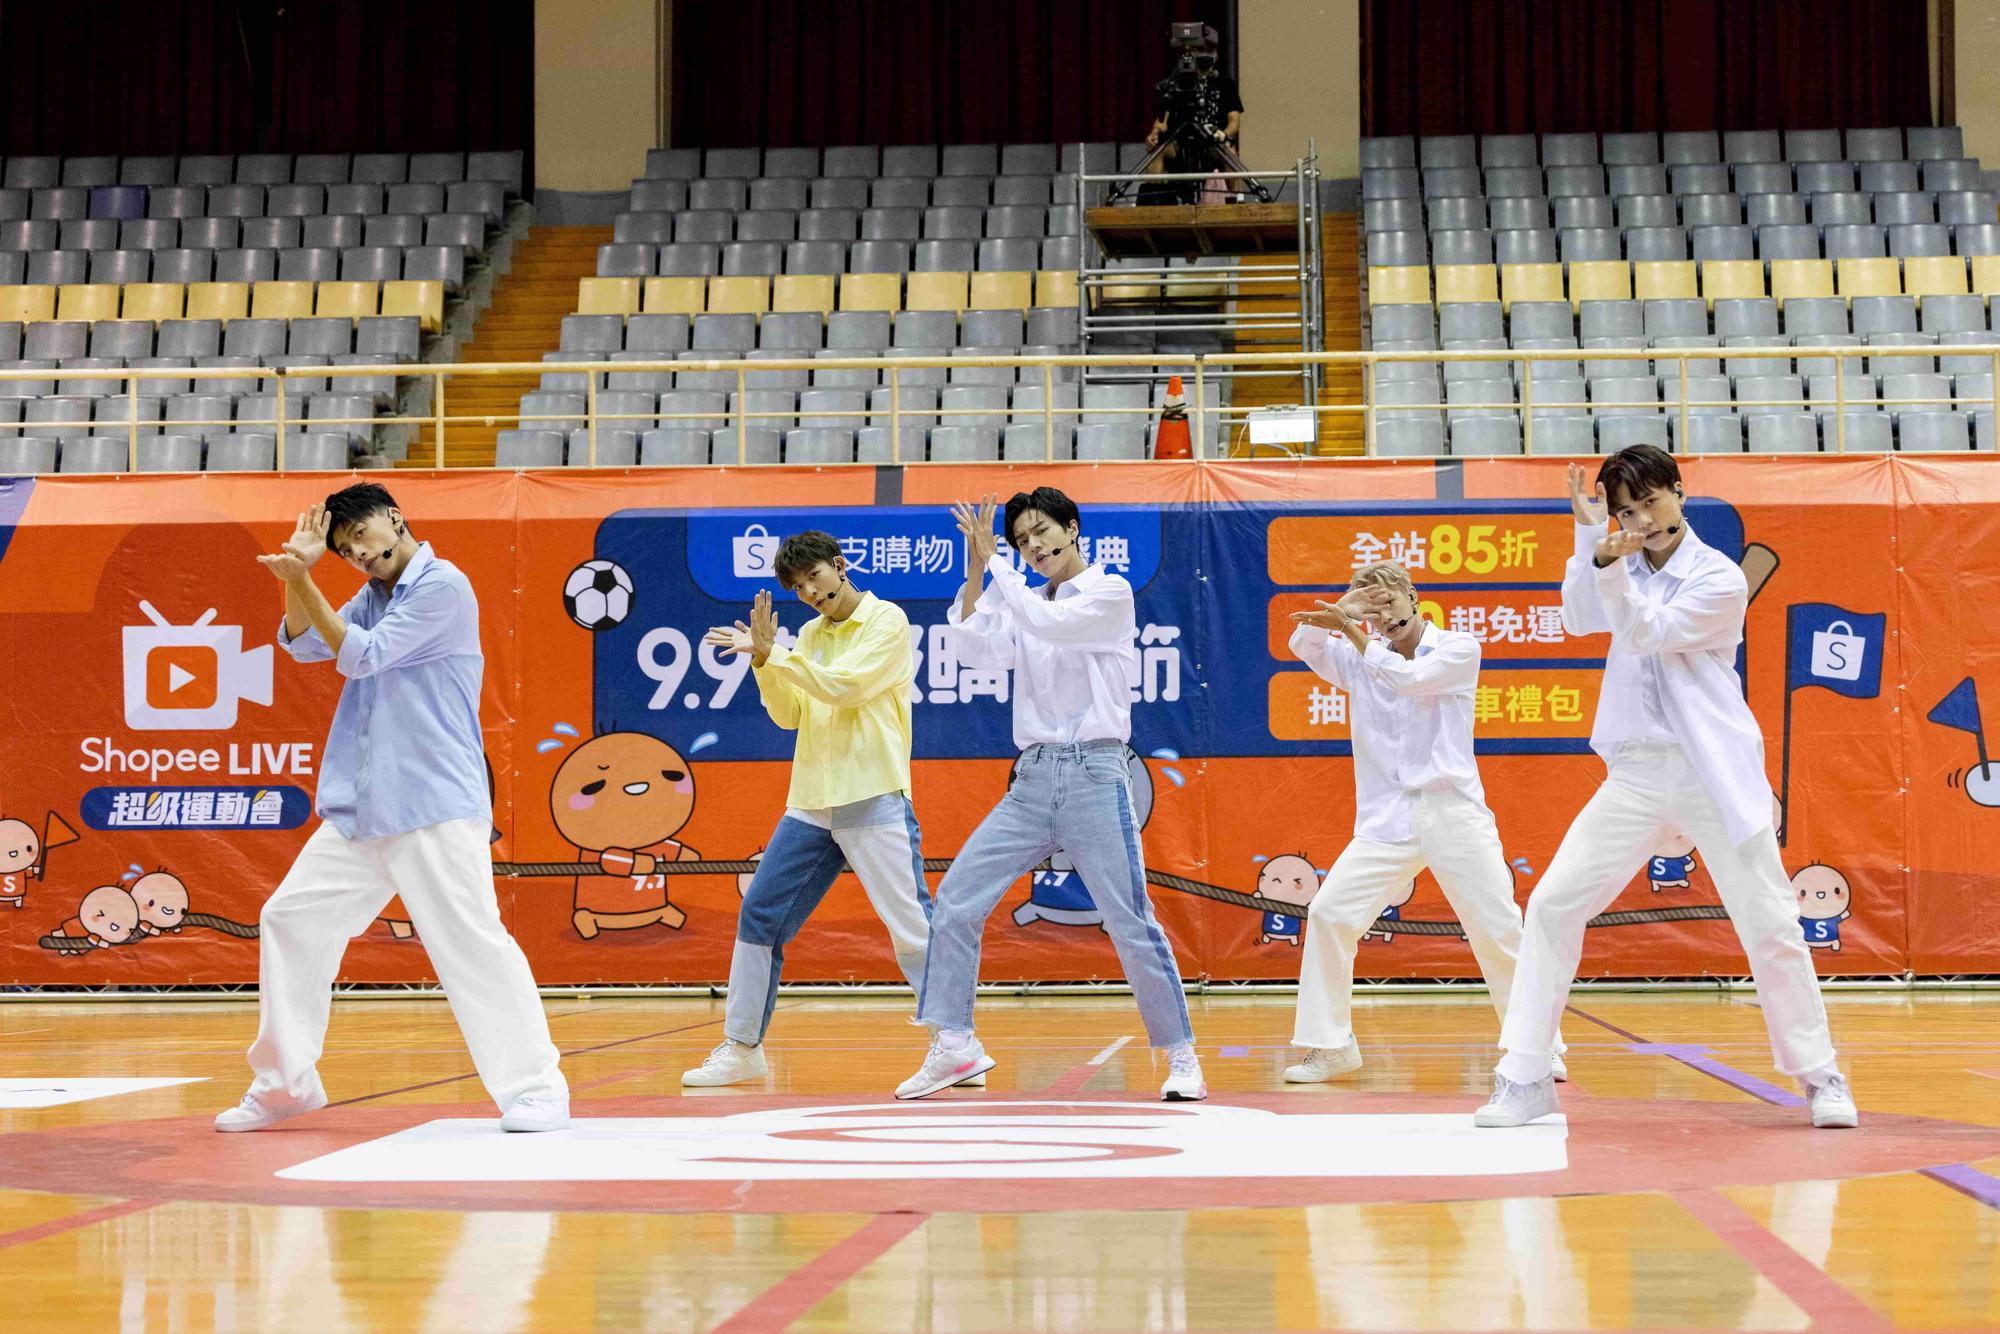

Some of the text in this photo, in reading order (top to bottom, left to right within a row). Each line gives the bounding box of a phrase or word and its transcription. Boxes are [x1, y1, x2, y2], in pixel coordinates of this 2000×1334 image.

[747, 543, 765, 570] S
[1350, 524, 1538, 574] 全站85折
[1827, 641, 1847, 671] S
[80, 737, 313, 782] Shopee LIVE
[1652, 858, 1667, 876] S
[3, 875, 16, 893] S
[1271, 914, 1285, 931] S
[1815, 921, 1828, 939] S
